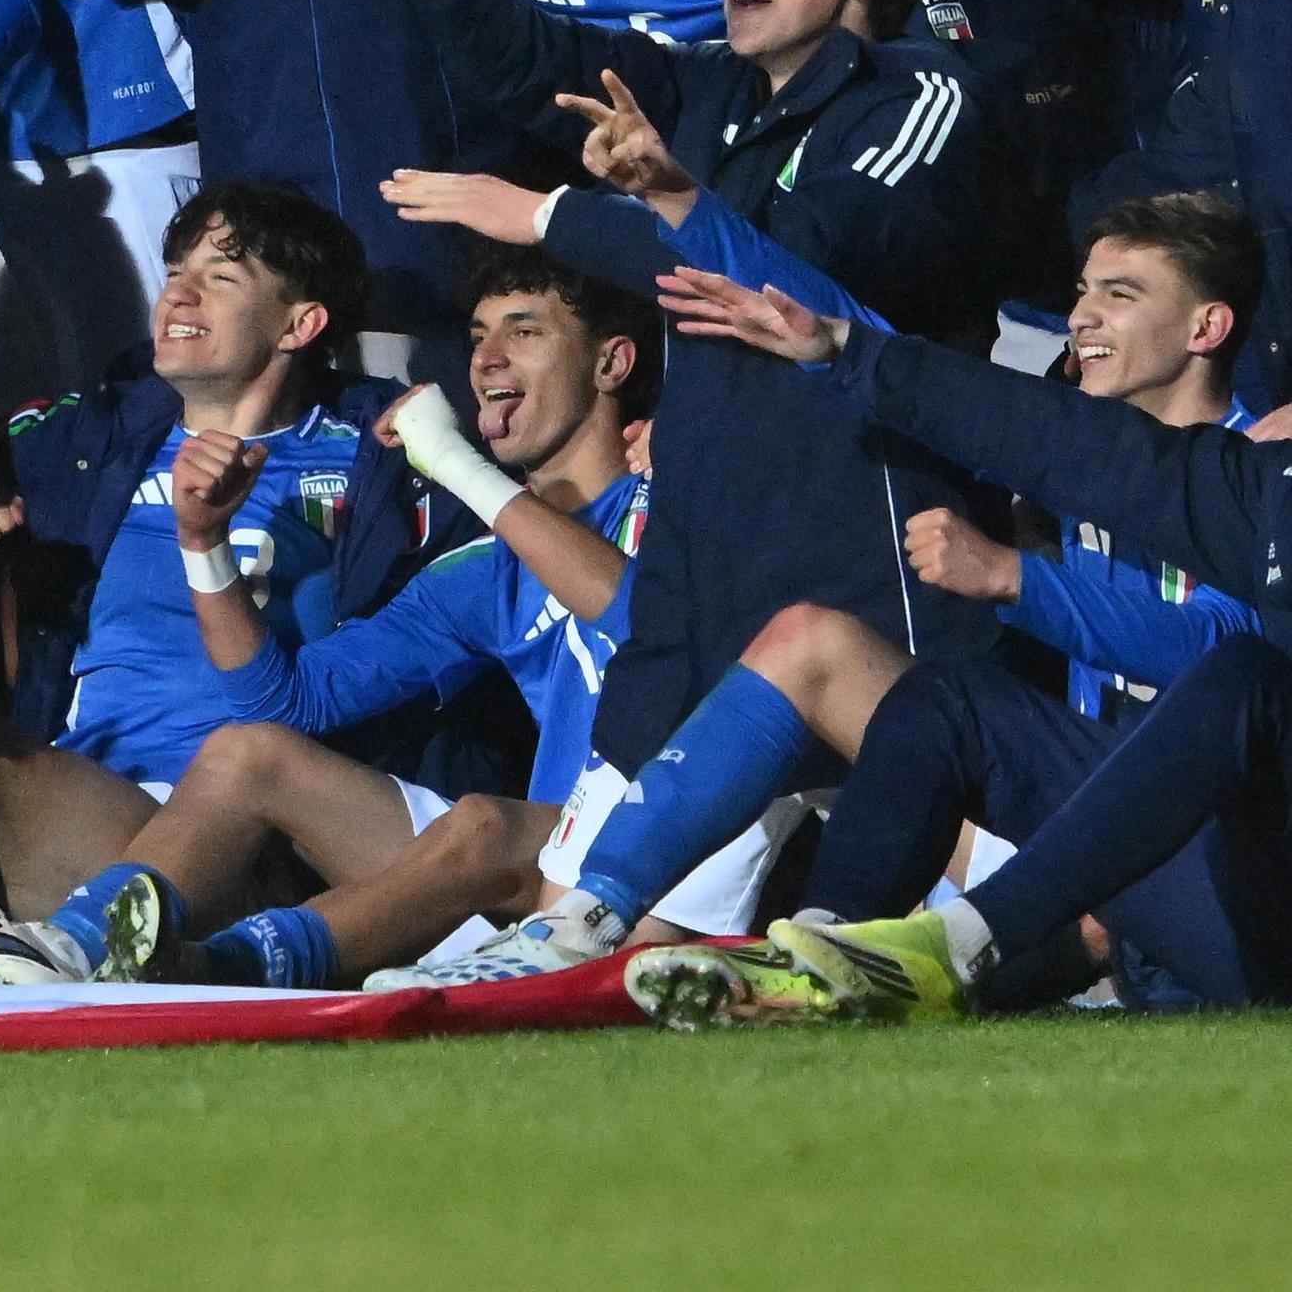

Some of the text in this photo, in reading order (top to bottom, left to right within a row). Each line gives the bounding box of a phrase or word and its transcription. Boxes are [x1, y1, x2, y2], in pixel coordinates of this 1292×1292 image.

[931, 7, 965, 25] ITALIA
[1025, 90, 1052, 104] eni
[305, 480, 345, 495] ITALIA
